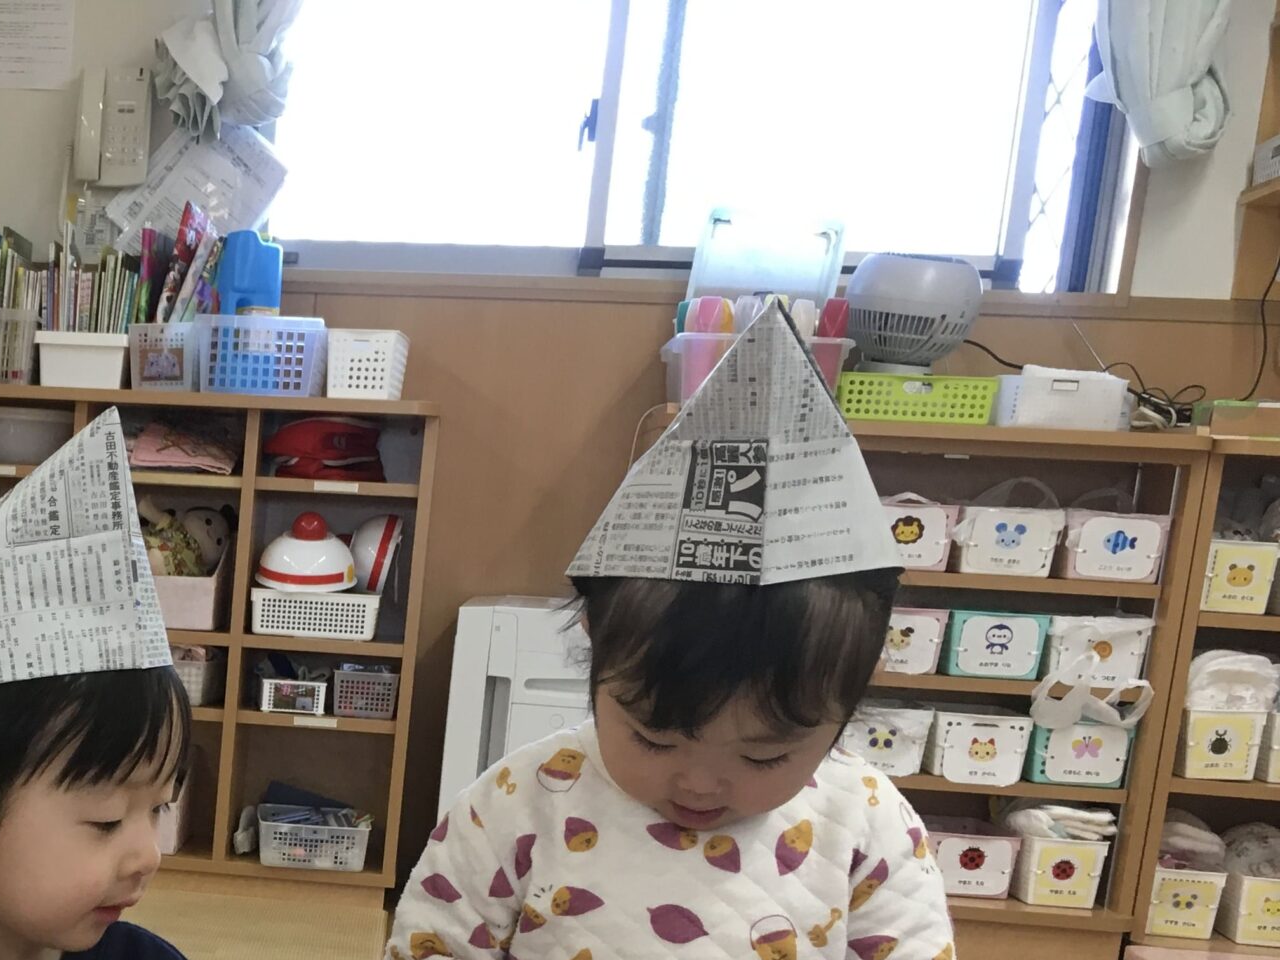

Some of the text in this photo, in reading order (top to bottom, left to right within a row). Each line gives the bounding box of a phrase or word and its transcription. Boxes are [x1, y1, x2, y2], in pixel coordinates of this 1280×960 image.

[105, 431, 124, 531] 古田不動産鑑定事務所
